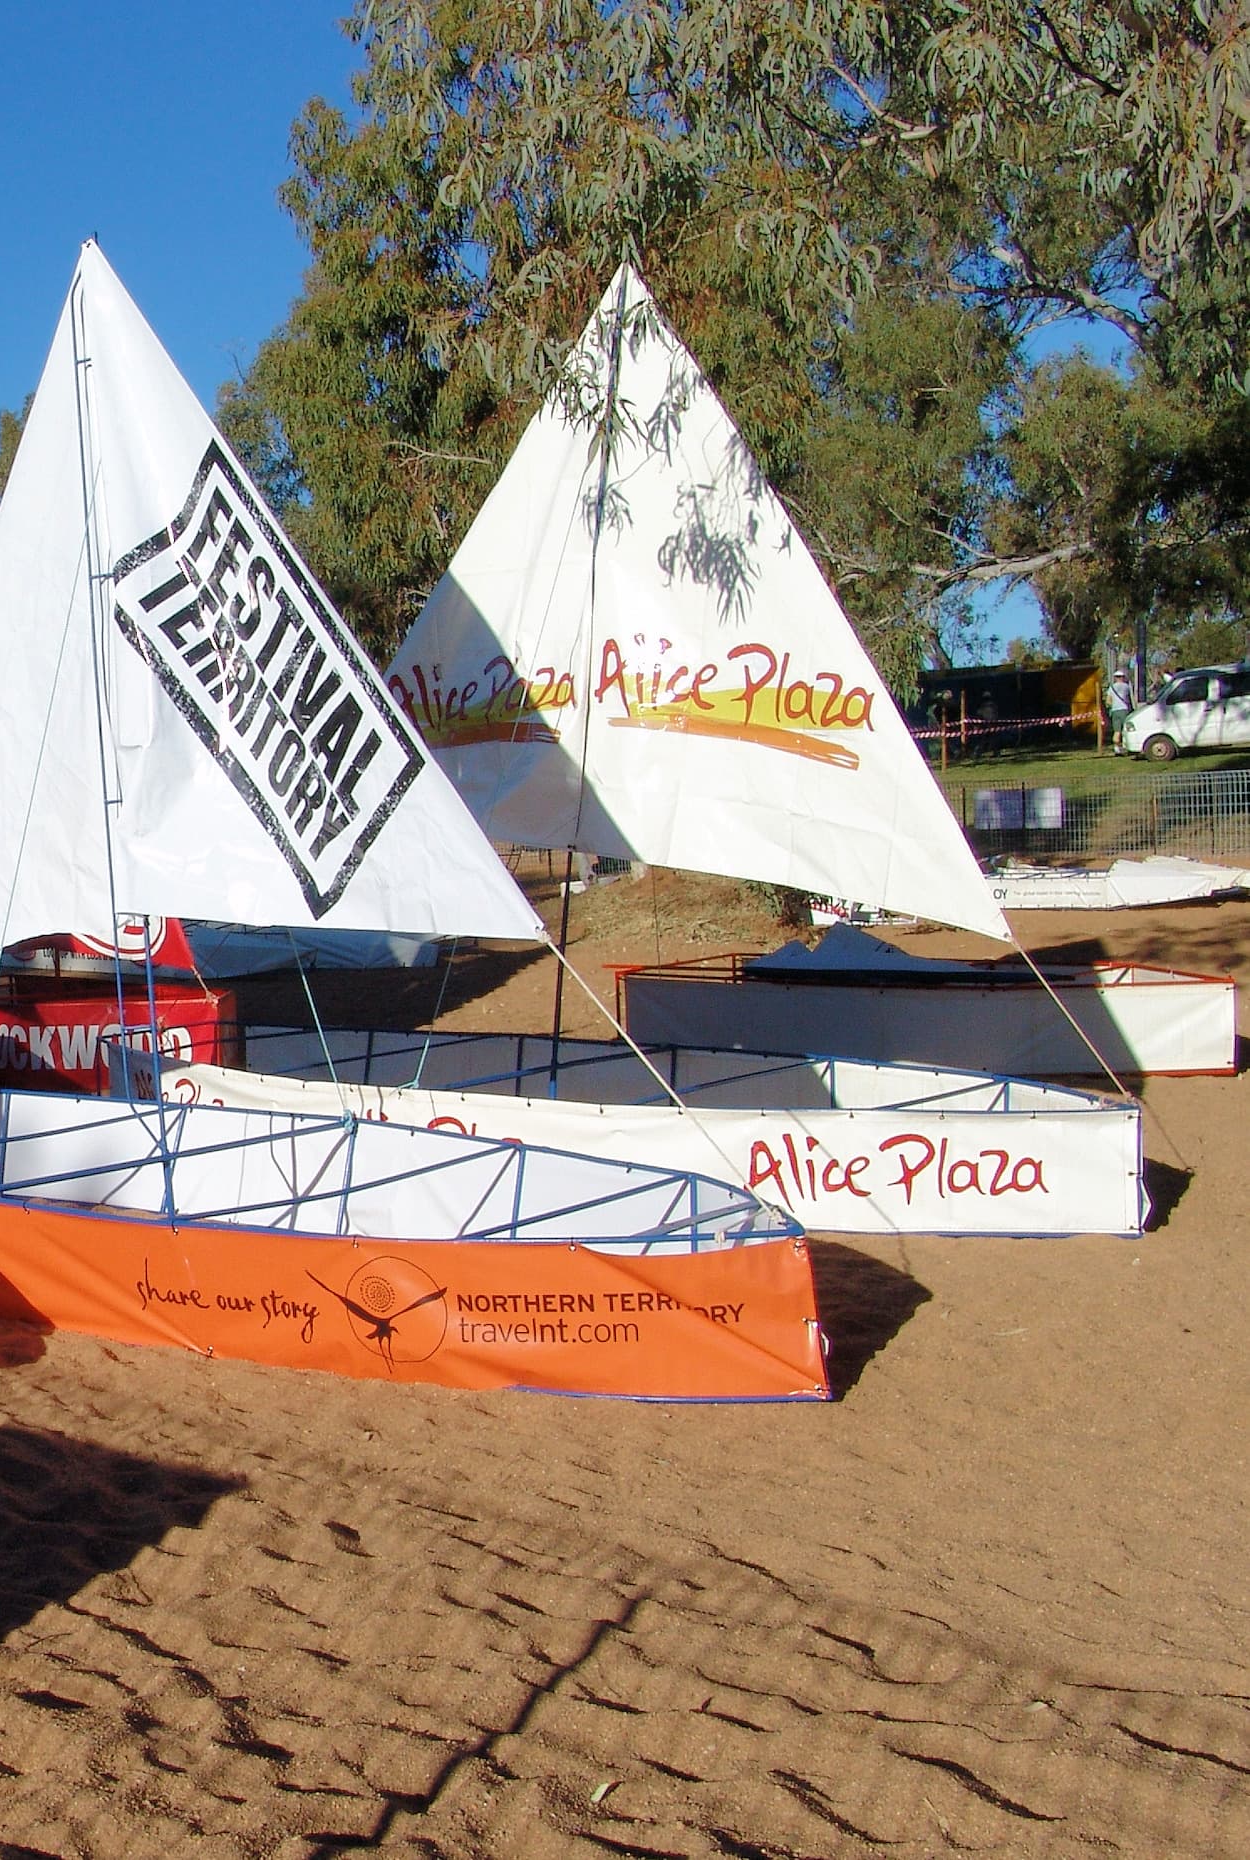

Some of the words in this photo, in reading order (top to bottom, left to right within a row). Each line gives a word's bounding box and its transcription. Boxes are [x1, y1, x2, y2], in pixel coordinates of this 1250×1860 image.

[187, 487, 383, 820] FESTIVAL
[594, 633, 719, 717] Alice
[726, 643, 876, 733] Plaza
[743, 1133, 872, 1213] Alice
[878, 1133, 1050, 1205] Plaza
[136, 1257, 210, 1311] share
[216, 1294, 256, 1312] our
[260, 1289, 320, 1344] story
[456, 1293, 595, 1313] NORTHERN
[458, 1316, 639, 1343] travelnt.com
